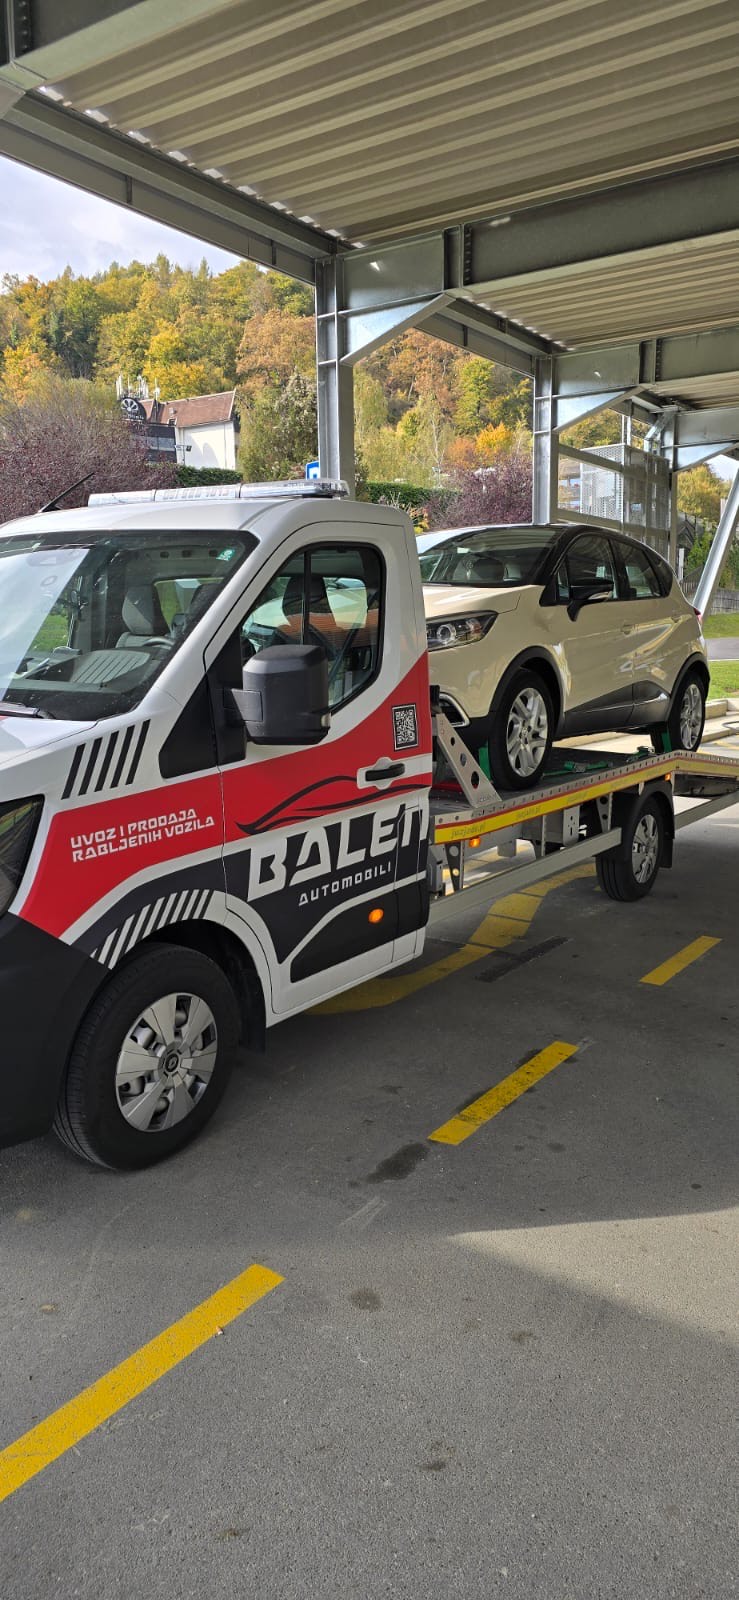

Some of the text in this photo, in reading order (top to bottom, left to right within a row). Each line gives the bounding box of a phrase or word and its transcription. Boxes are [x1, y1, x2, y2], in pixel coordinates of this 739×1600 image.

[71, 808, 198, 849] UVOZ I PRODAJA
[72, 816, 215, 862] RABLJENIH VOZILA
[247, 797, 430, 902] BALEN
[298, 861, 392, 907] AUTOMOBILI
